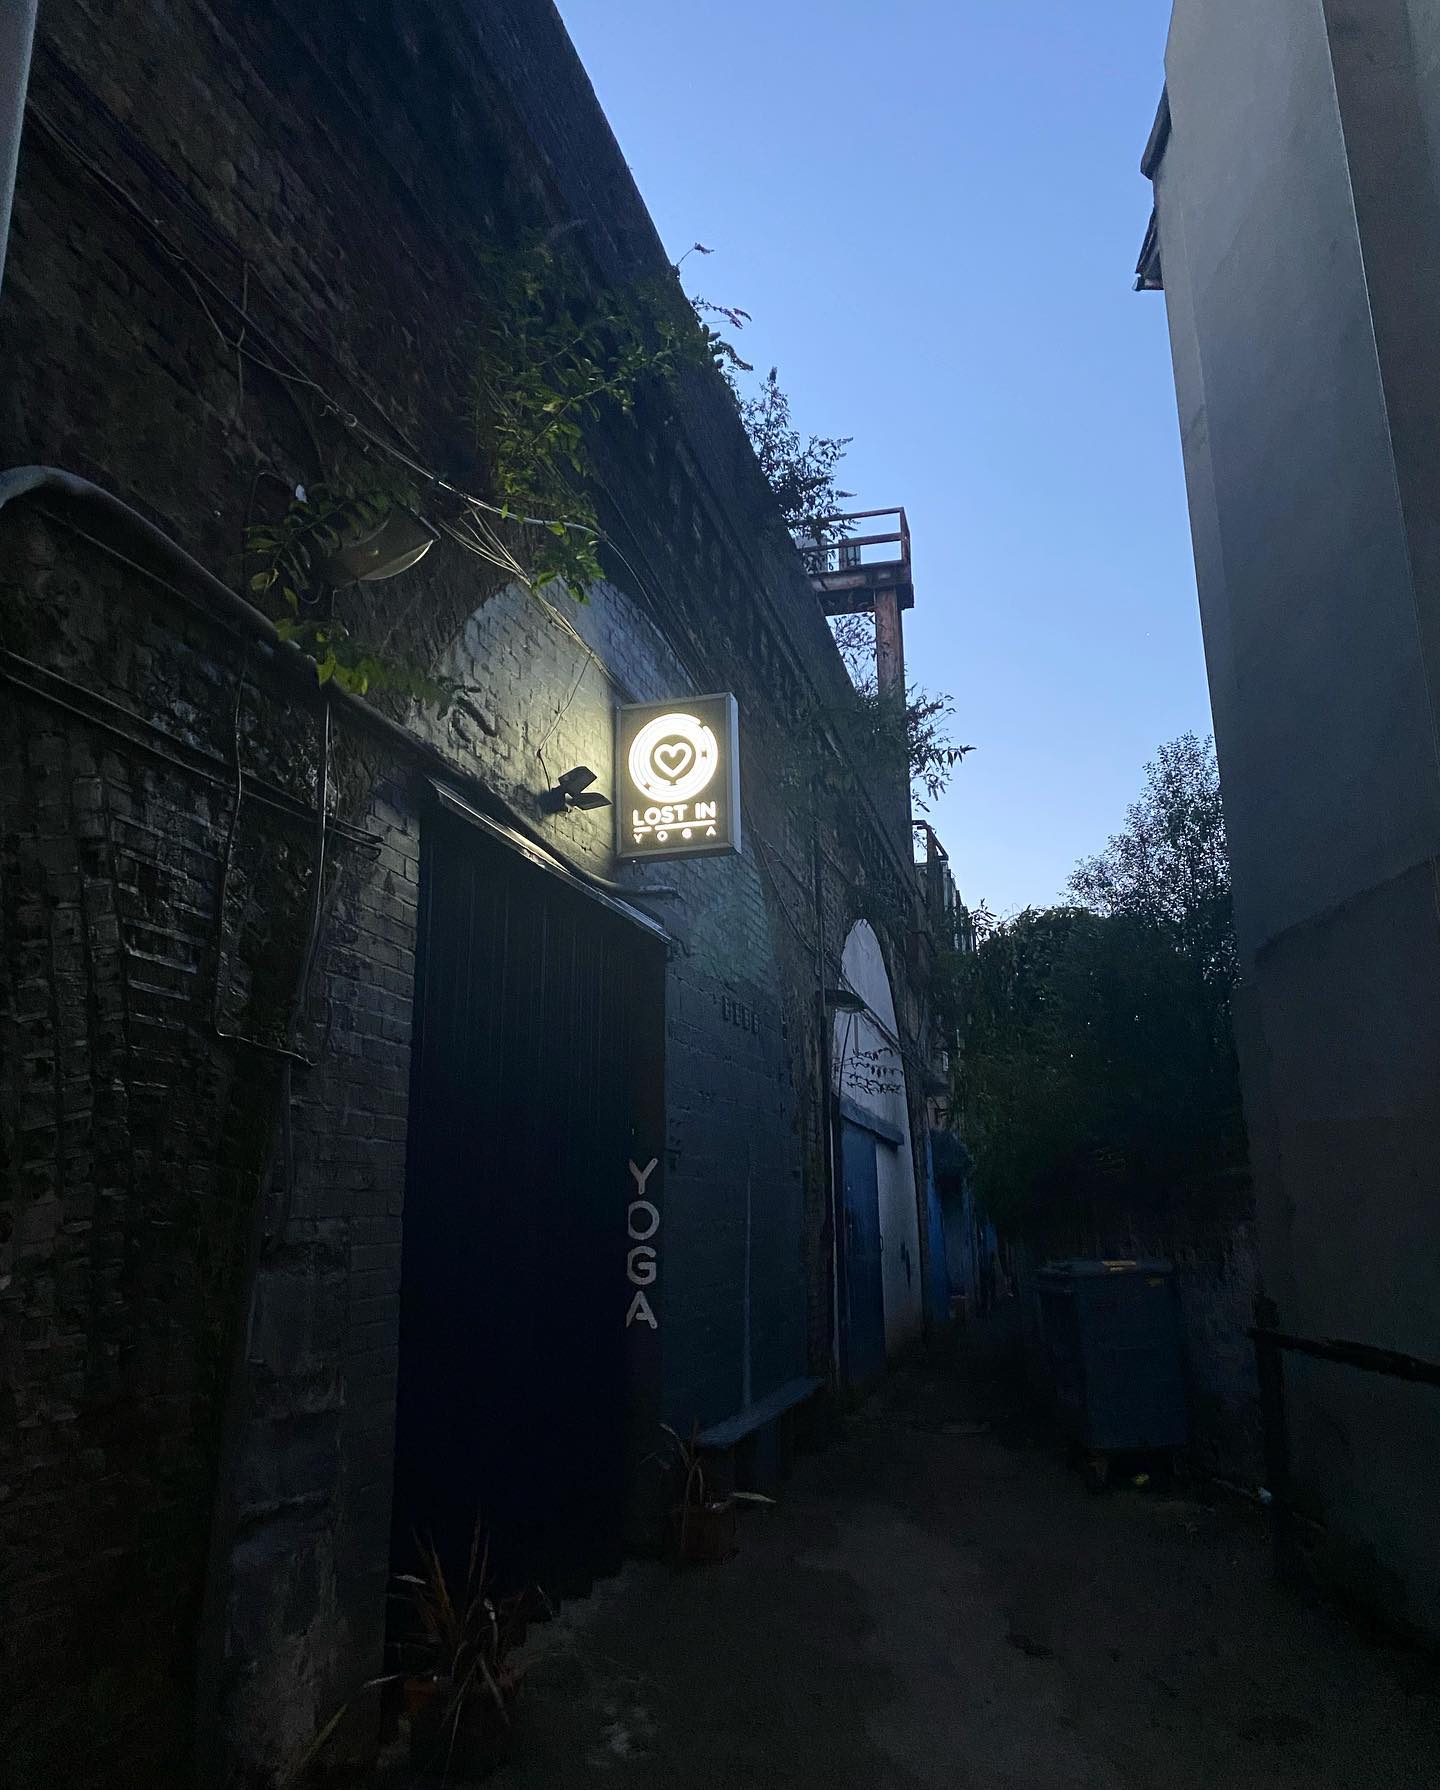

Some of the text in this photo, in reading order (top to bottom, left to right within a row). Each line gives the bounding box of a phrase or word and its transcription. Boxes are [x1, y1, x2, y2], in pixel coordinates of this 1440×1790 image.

[633, 801, 716, 826] LOST IN
[626, 1157, 660, 1329] YOGA
